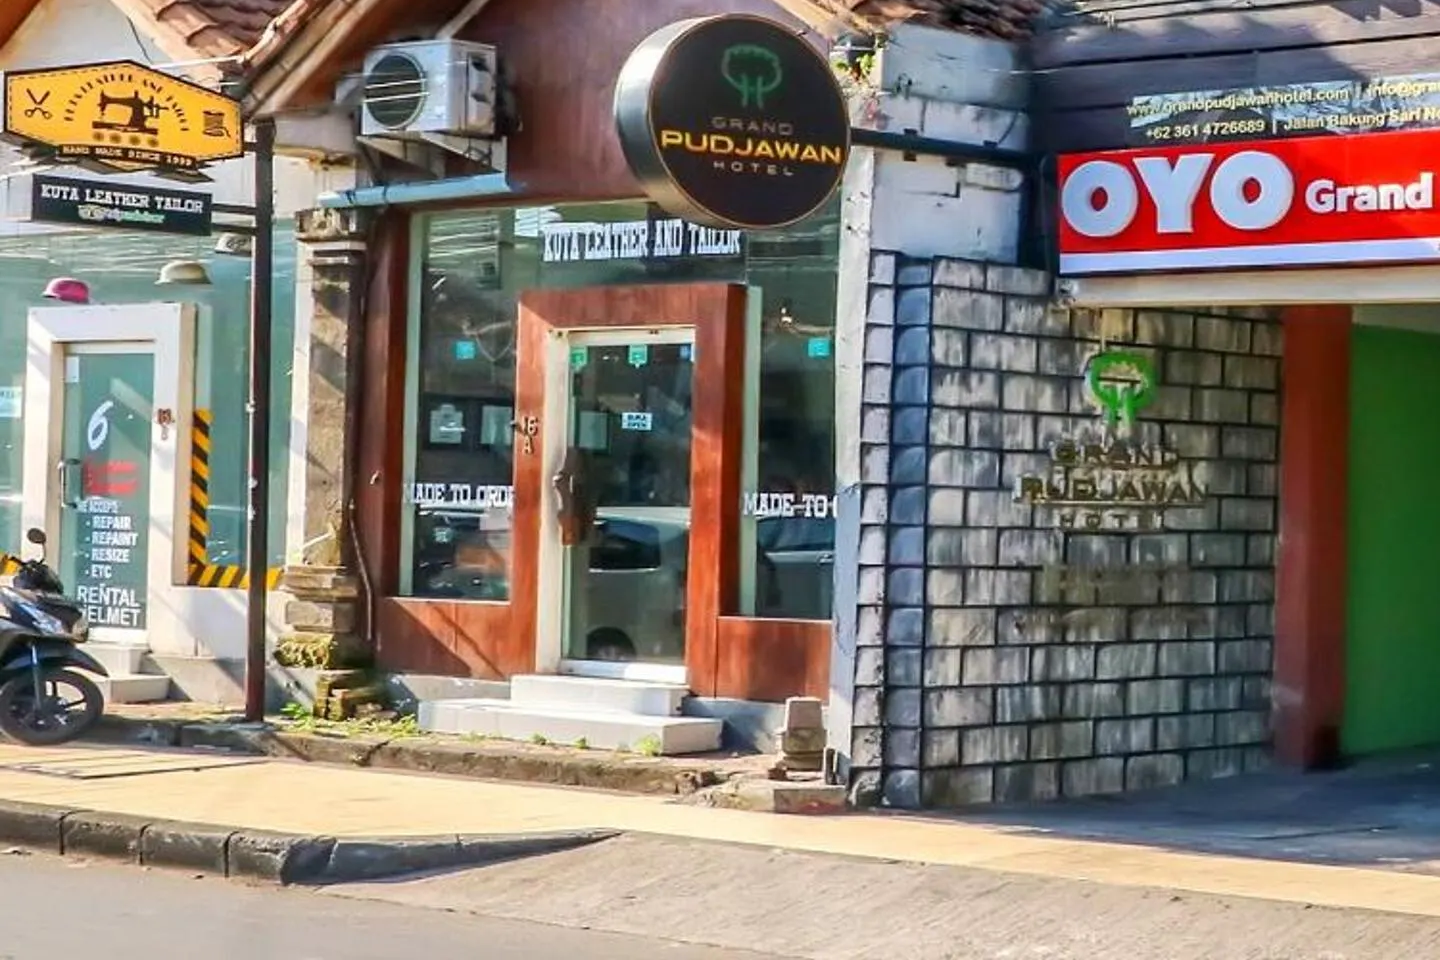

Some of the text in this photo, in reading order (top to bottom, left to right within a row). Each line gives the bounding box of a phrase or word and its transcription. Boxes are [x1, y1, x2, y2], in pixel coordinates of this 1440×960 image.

[1127, 88, 1350, 117] www.grandpudjawanhotel.com
[711, 117, 794, 136] GRAND
[1146, 125, 1170, 139] +62
[1174, 123, 1198, 138] 361
[1284, 113, 1324, 131] Jalan
[1329, 111, 1386, 128] Bakung
[1390, 107, 1421, 122] Sari
[660, 130, 842, 164] PUDJAWAN
[713, 161, 794, 176] HOTEL
[41, 184, 203, 214] KUTA LEATHER TAILOR
[1061, 150, 1295, 238] OYO
[1305, 172, 1434, 214] Grand
[541, 227, 580, 262] KUTA
[584, 222, 648, 260] LEATHER
[653, 219, 684, 257] AND
[91, 515, 132, 529] REPAIR
[91, 531, 139, 546] REPAINT
[91, 547, 131, 563] RESIZE
[91, 563, 112, 578] ETC
[77, 585, 140, 607] RENTAL
